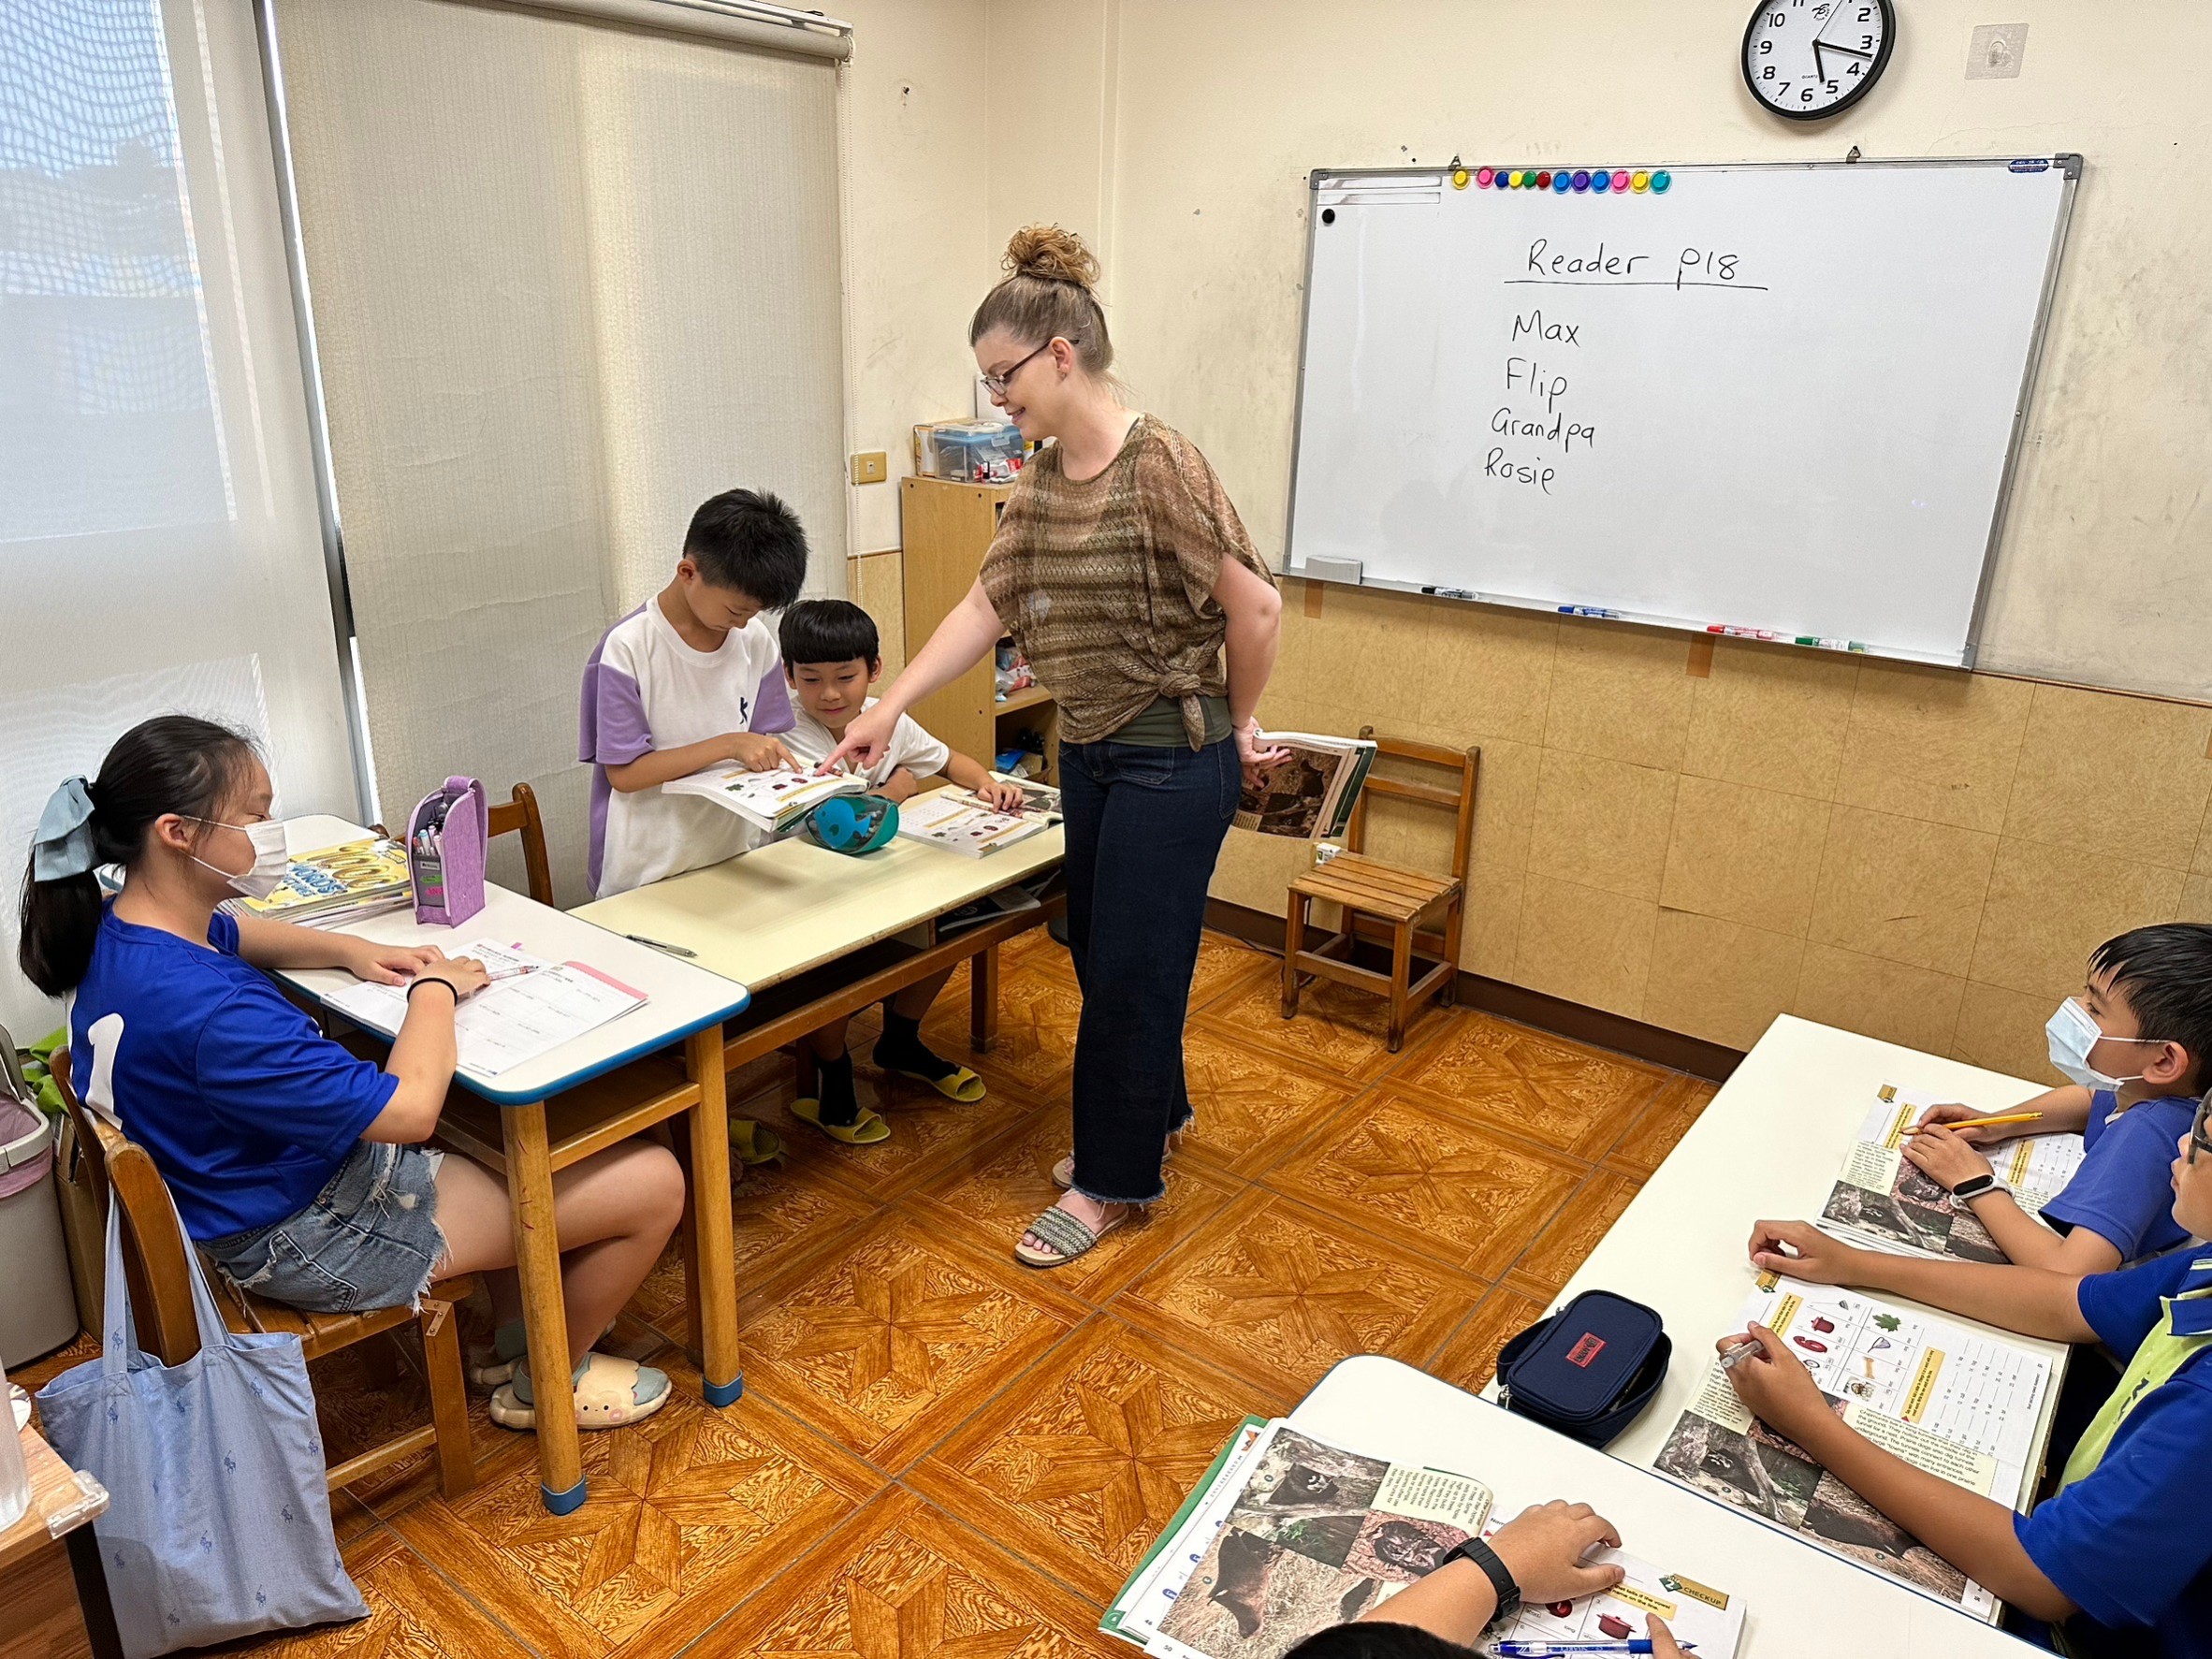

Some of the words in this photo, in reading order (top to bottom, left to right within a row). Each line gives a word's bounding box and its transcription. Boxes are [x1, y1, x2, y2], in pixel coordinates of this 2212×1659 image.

[1768, 13, 1785, 27] 10
[1857, 7, 1870, 22] 2
[1760, 40, 1772, 54] 9
[1860, 36, 1872, 50] 3
[1763, 66, 1776, 80] 8
[1846, 62, 1860, 76] 4
[1778, 81, 1791, 96] 7
[1826, 80, 1839, 94] 5
[1800, 88, 1813, 102] 6
[1527, 239, 1650, 276] Reader
[1677, 248, 1739, 291] p18
[1512, 310, 1581, 348] Max
[1506, 357, 1567, 414] Flip
[1491, 407, 1594, 453] Grandpa
[1484, 447, 1555, 496] Rosie
[1665, 1579, 1675, 1590] 2
[1683, 1586, 1722, 1606] CHECKUP
